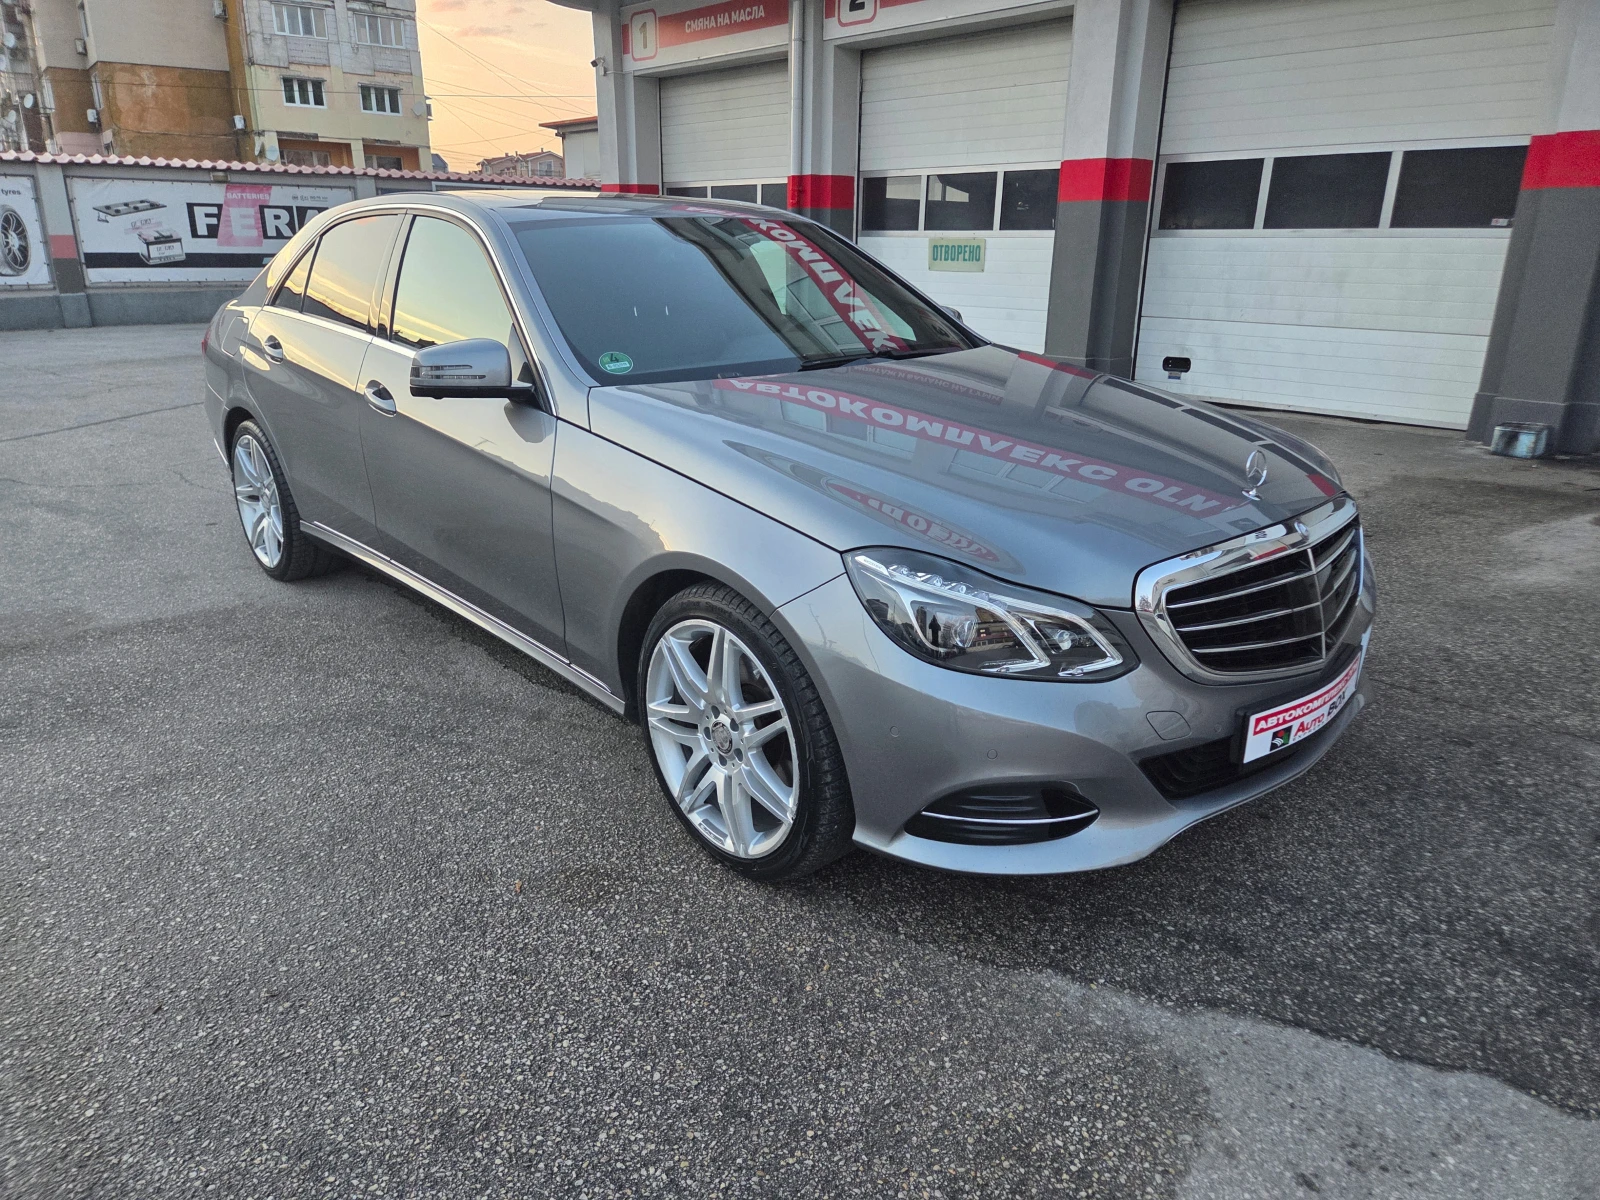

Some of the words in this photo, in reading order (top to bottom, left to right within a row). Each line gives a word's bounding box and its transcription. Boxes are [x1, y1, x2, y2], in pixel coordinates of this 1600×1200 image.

[685, 16, 716, 33] СМЯНА
[717, 14, 730, 27] НА
[731, 5, 765, 23] МАСЛА
[638, 21, 648, 49] 1
[1, 188, 21, 196] tyres
[226, 192, 270, 200] BATTERIES
[932, 244, 981, 262] ОТВОРЕНО
